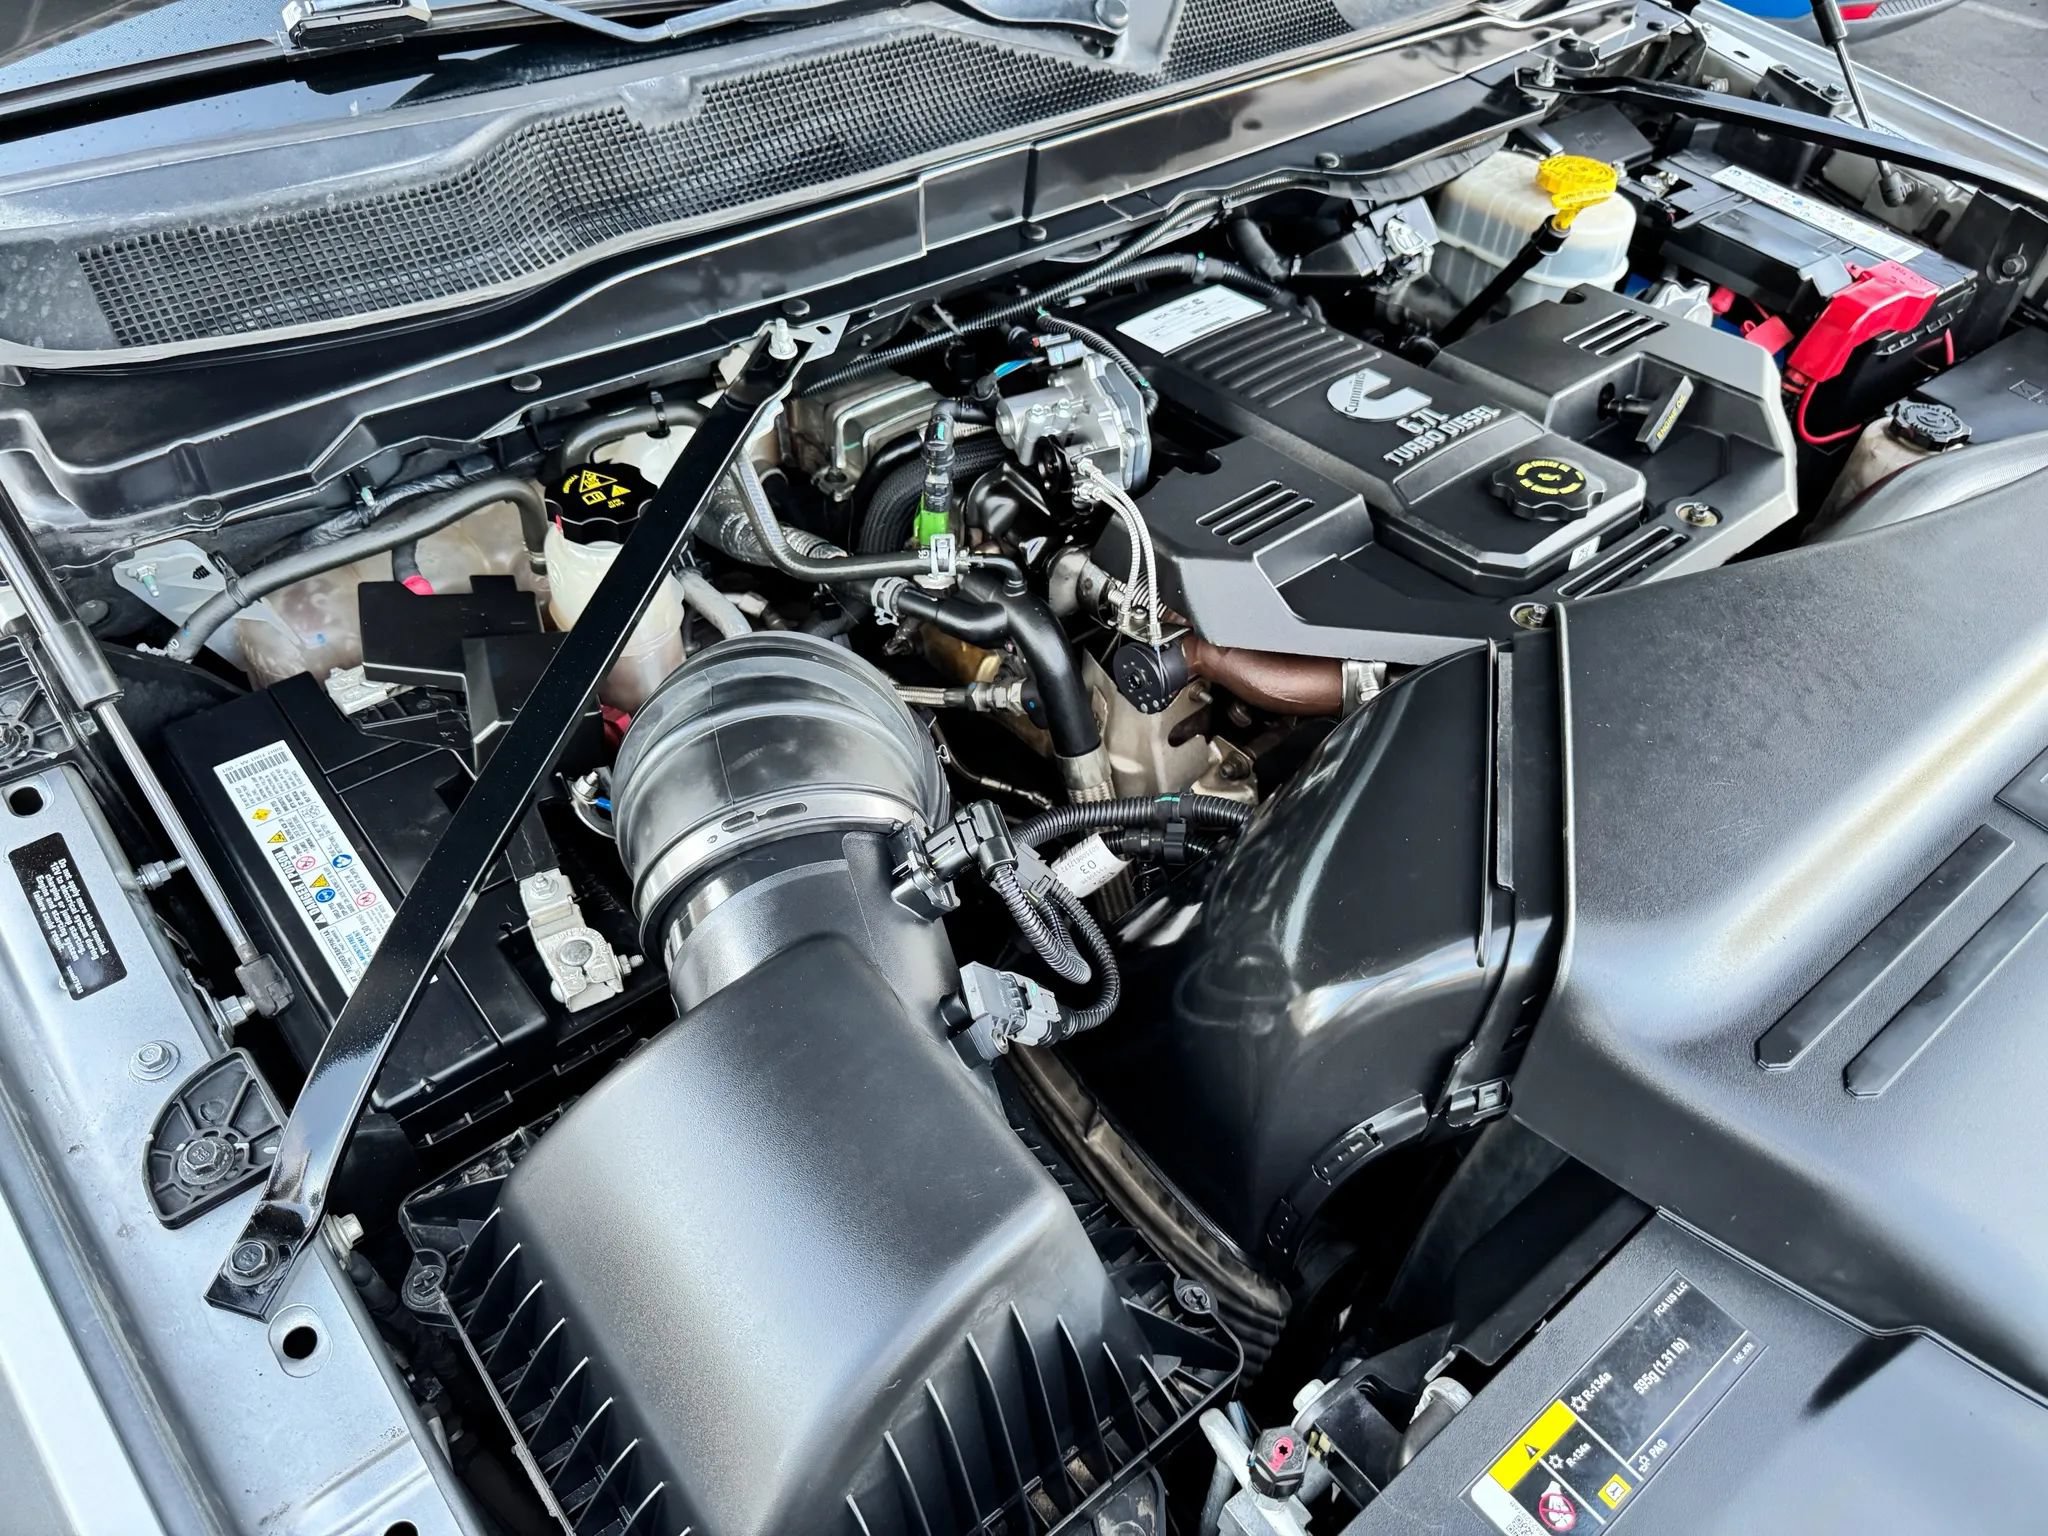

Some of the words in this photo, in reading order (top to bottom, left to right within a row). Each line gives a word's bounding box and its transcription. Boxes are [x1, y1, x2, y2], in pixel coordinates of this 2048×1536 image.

[1345, 372, 1367, 413] Cummins
[1383, 429, 1446, 466] TURBO
[1440, 405, 1501, 437] DIESEL
[1396, 407, 1449, 435] 6.7L
[1656, 408, 1677, 440] ENGINE
[1676, 394, 1687, 409] OIL
[274, 849, 298, 880] POISON
[36, 875, 49, 898] Engine
[46, 898, 57, 909] and
[52, 910, 68, 937] starting
[65, 937, 79, 961] system
[42, 874, 61, 901] charging
[60, 908, 72, 926] jump
[69, 926, 85, 955] starting.
[50, 862, 62, 875] 12V
[56, 876, 63, 884] to
[60, 884, 79, 914] electrical
[74, 914, 89, 938] system
[82, 938, 99, 960] during
[58, 858, 66, 868] Do
[63, 869, 72, 880] not
[68, 880, 80, 897] apply
[76, 898, 87, 913] more
[84, 914, 95, 929] than
[92, 930, 109, 955] nominal
[294, 881, 320, 916] DANGER
[33, 891, 46, 912] failure
[42, 912, 56, 929] could
[51, 930, 64, 952] result.
[361, 924, 372, 936] 130
[1654, 1302, 1669, 1316] FCA
[1665, 1293, 1677, 1304] US
[1674, 1282, 1688, 1296] LLC
[1582, 1372, 1612, 1401] R-134a
[1634, 1371, 1660, 1394] 595g
[1653, 1349, 1677, 1375] (1.31
[1671, 1338, 1690, 1354] lb)
[1566, 1443, 1590, 1467] R-134a
[1649, 1439, 1667, 1458] PAG
